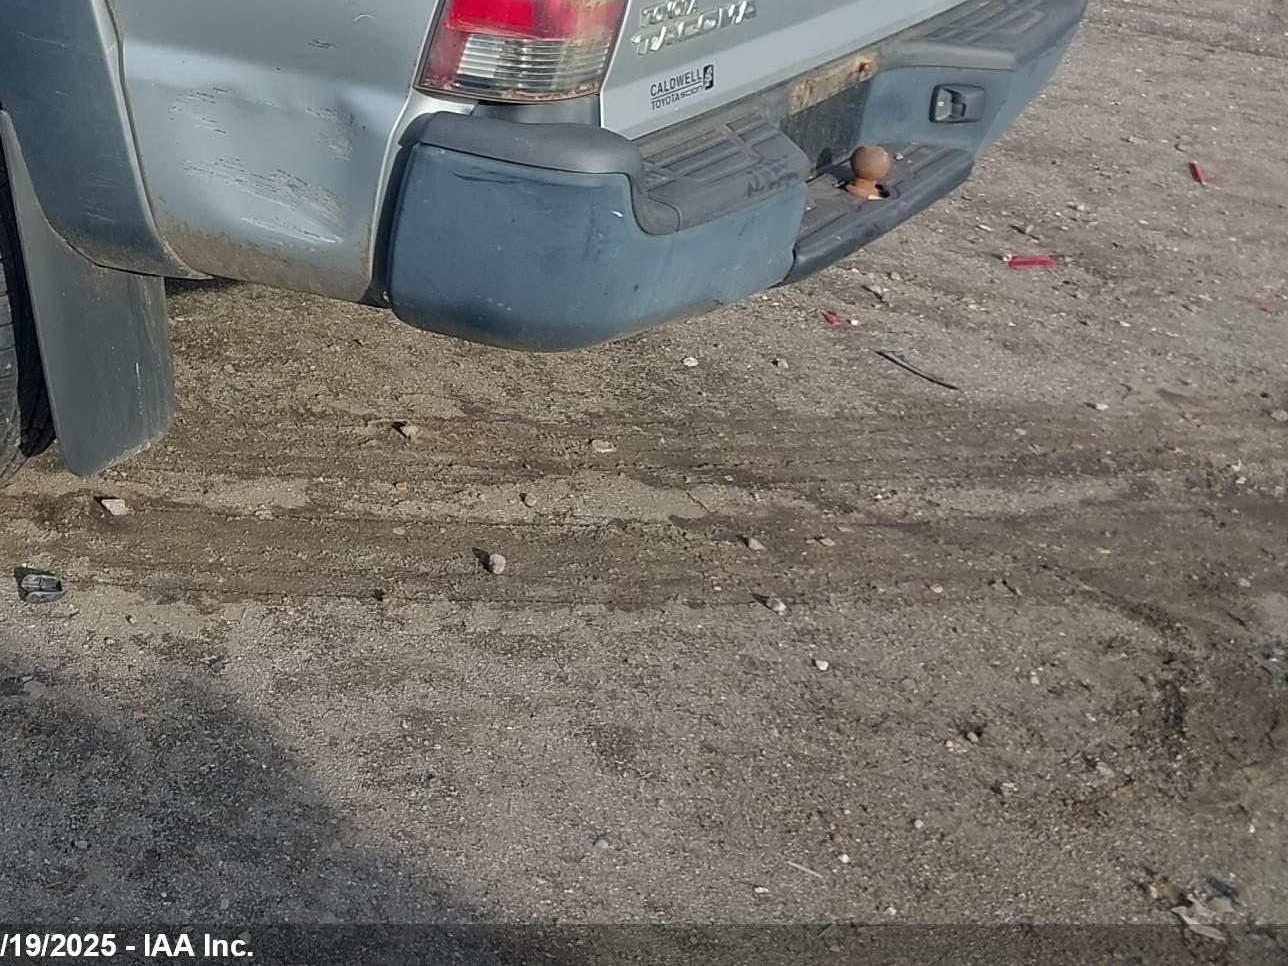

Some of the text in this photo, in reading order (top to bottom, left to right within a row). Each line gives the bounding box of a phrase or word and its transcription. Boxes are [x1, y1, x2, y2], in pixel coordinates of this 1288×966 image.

[630, 0, 758, 56] TACOMA
[649, 68, 703, 97] CALDWELL
[650, 92, 681, 111] TOYOTA
